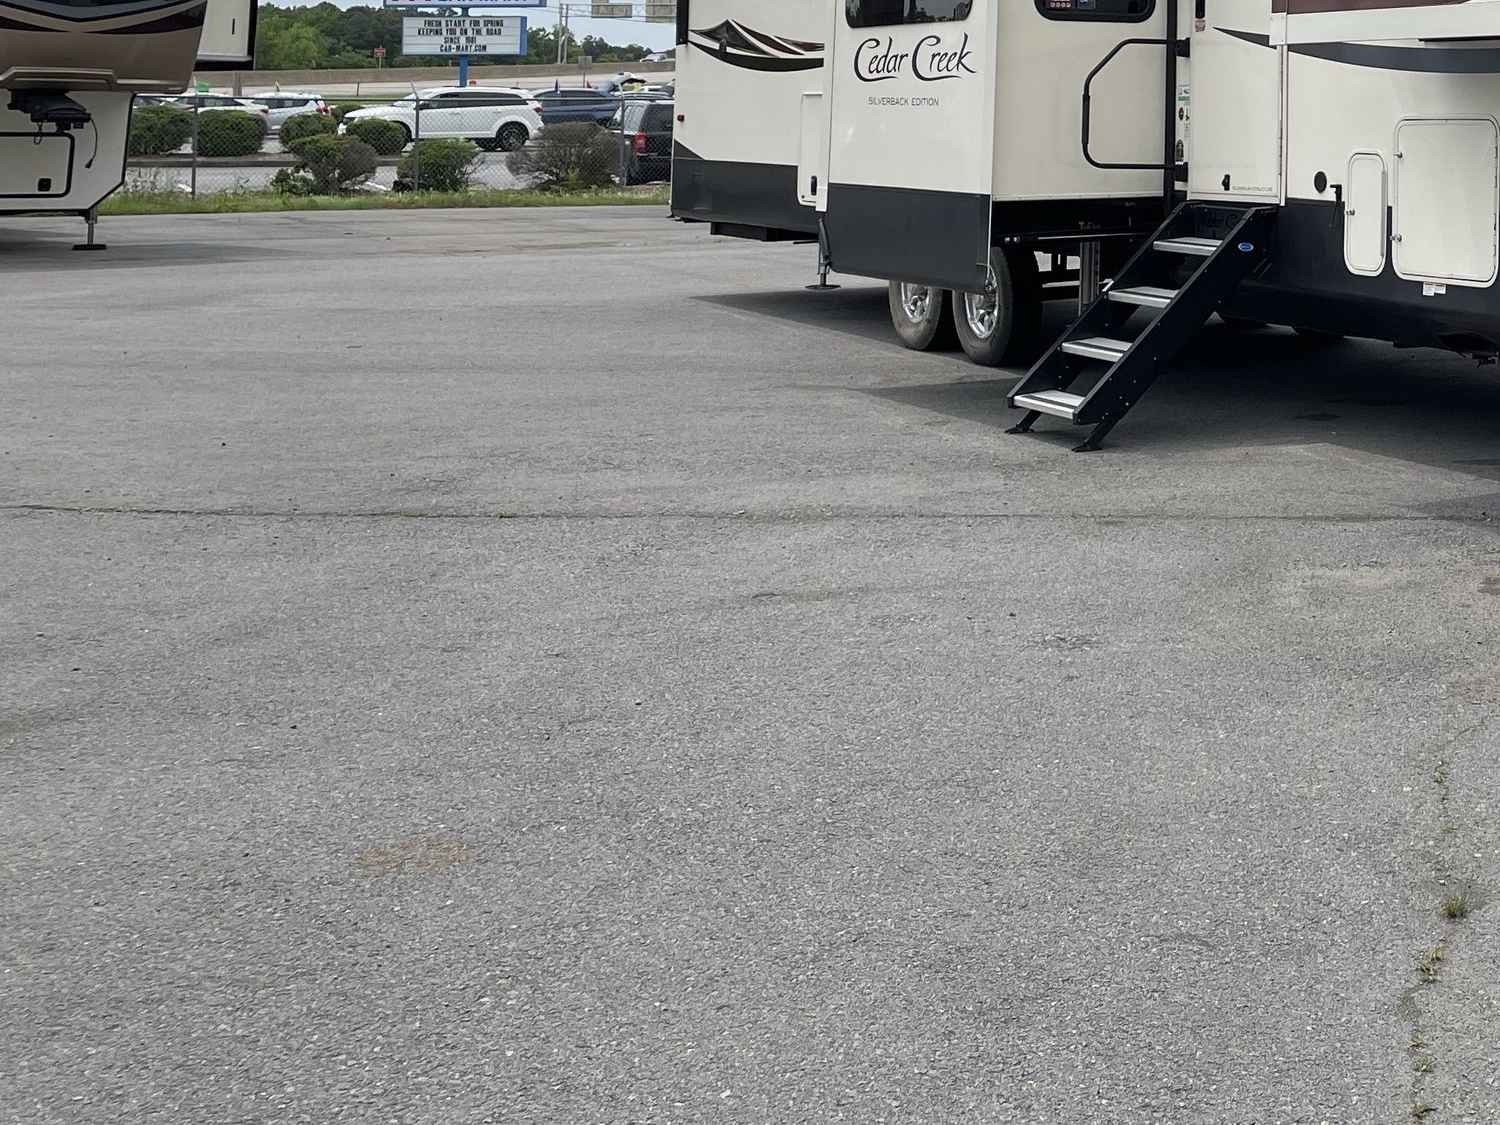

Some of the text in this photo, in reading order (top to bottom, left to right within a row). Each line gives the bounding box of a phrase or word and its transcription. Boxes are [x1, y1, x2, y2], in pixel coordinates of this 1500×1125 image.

[423, 19, 504, 28] FRESH START FOR SPRING
[417, 27, 502, 36] KEEPING YOU ON THE ROAD
[443, 36, 461, 45] SINCE
[853, 32, 978, 83] Cedar Creek
[868, 96, 939, 107] SILVERBACK EDITION
